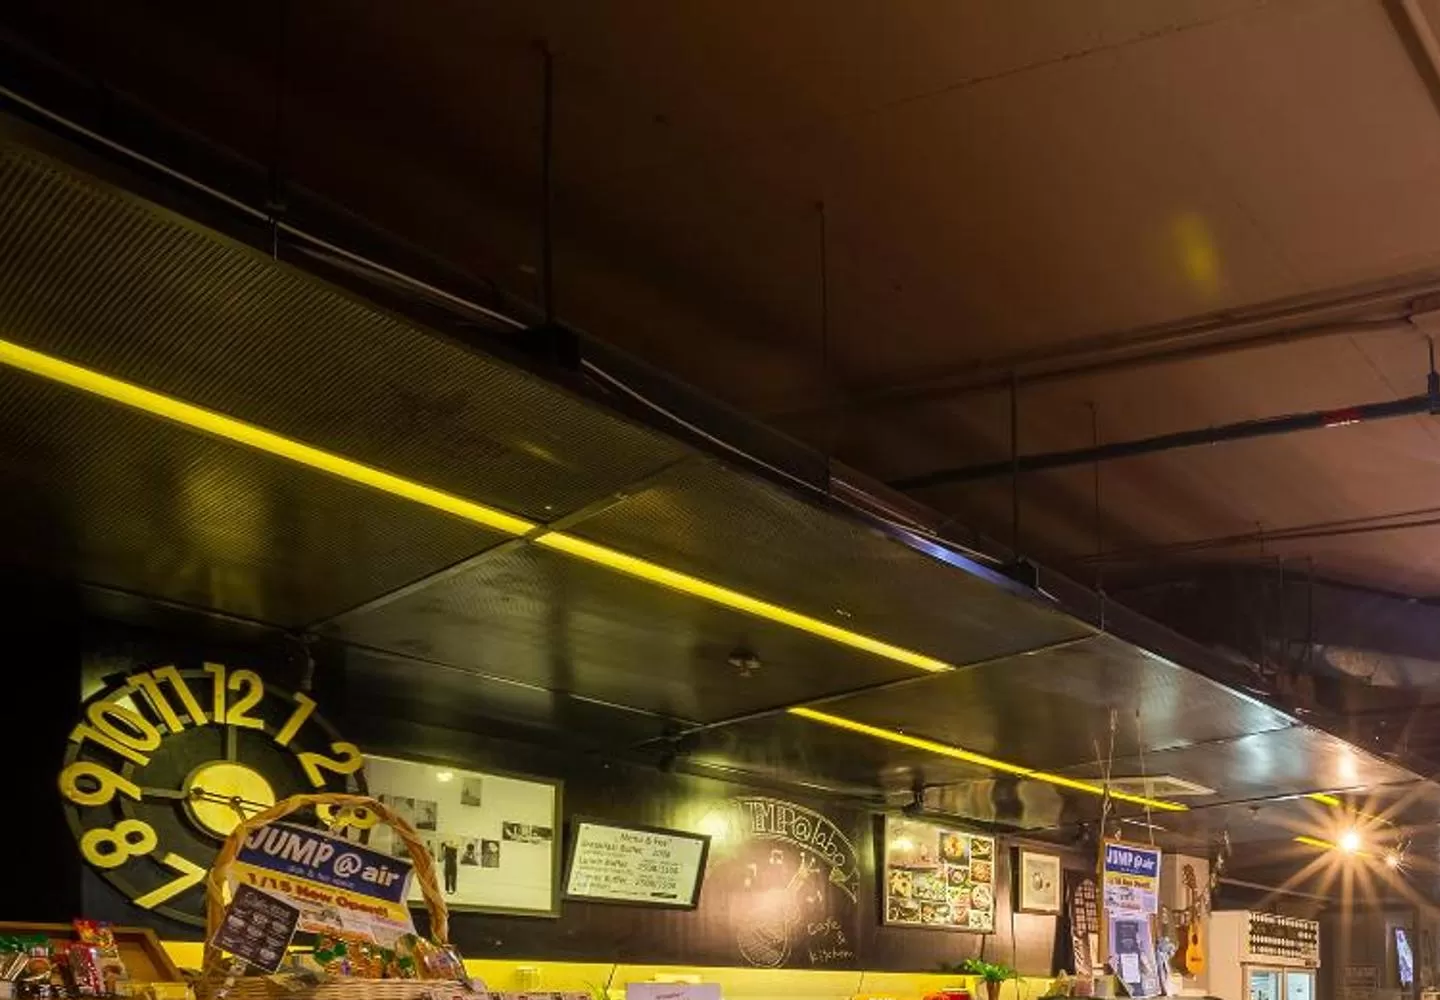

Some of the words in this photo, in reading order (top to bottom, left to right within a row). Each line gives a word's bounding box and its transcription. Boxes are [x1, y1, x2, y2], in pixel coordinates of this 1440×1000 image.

[126, 665, 208, 733] 11
[203, 662, 265, 730] 12
[274, 692, 318, 746] 1
[68, 700, 162, 767] 10
[58, 761, 143, 807] 9
[296, 741, 364, 788] 2
[80, 818, 158, 869] 8
[132, 852, 208, 910] 7
